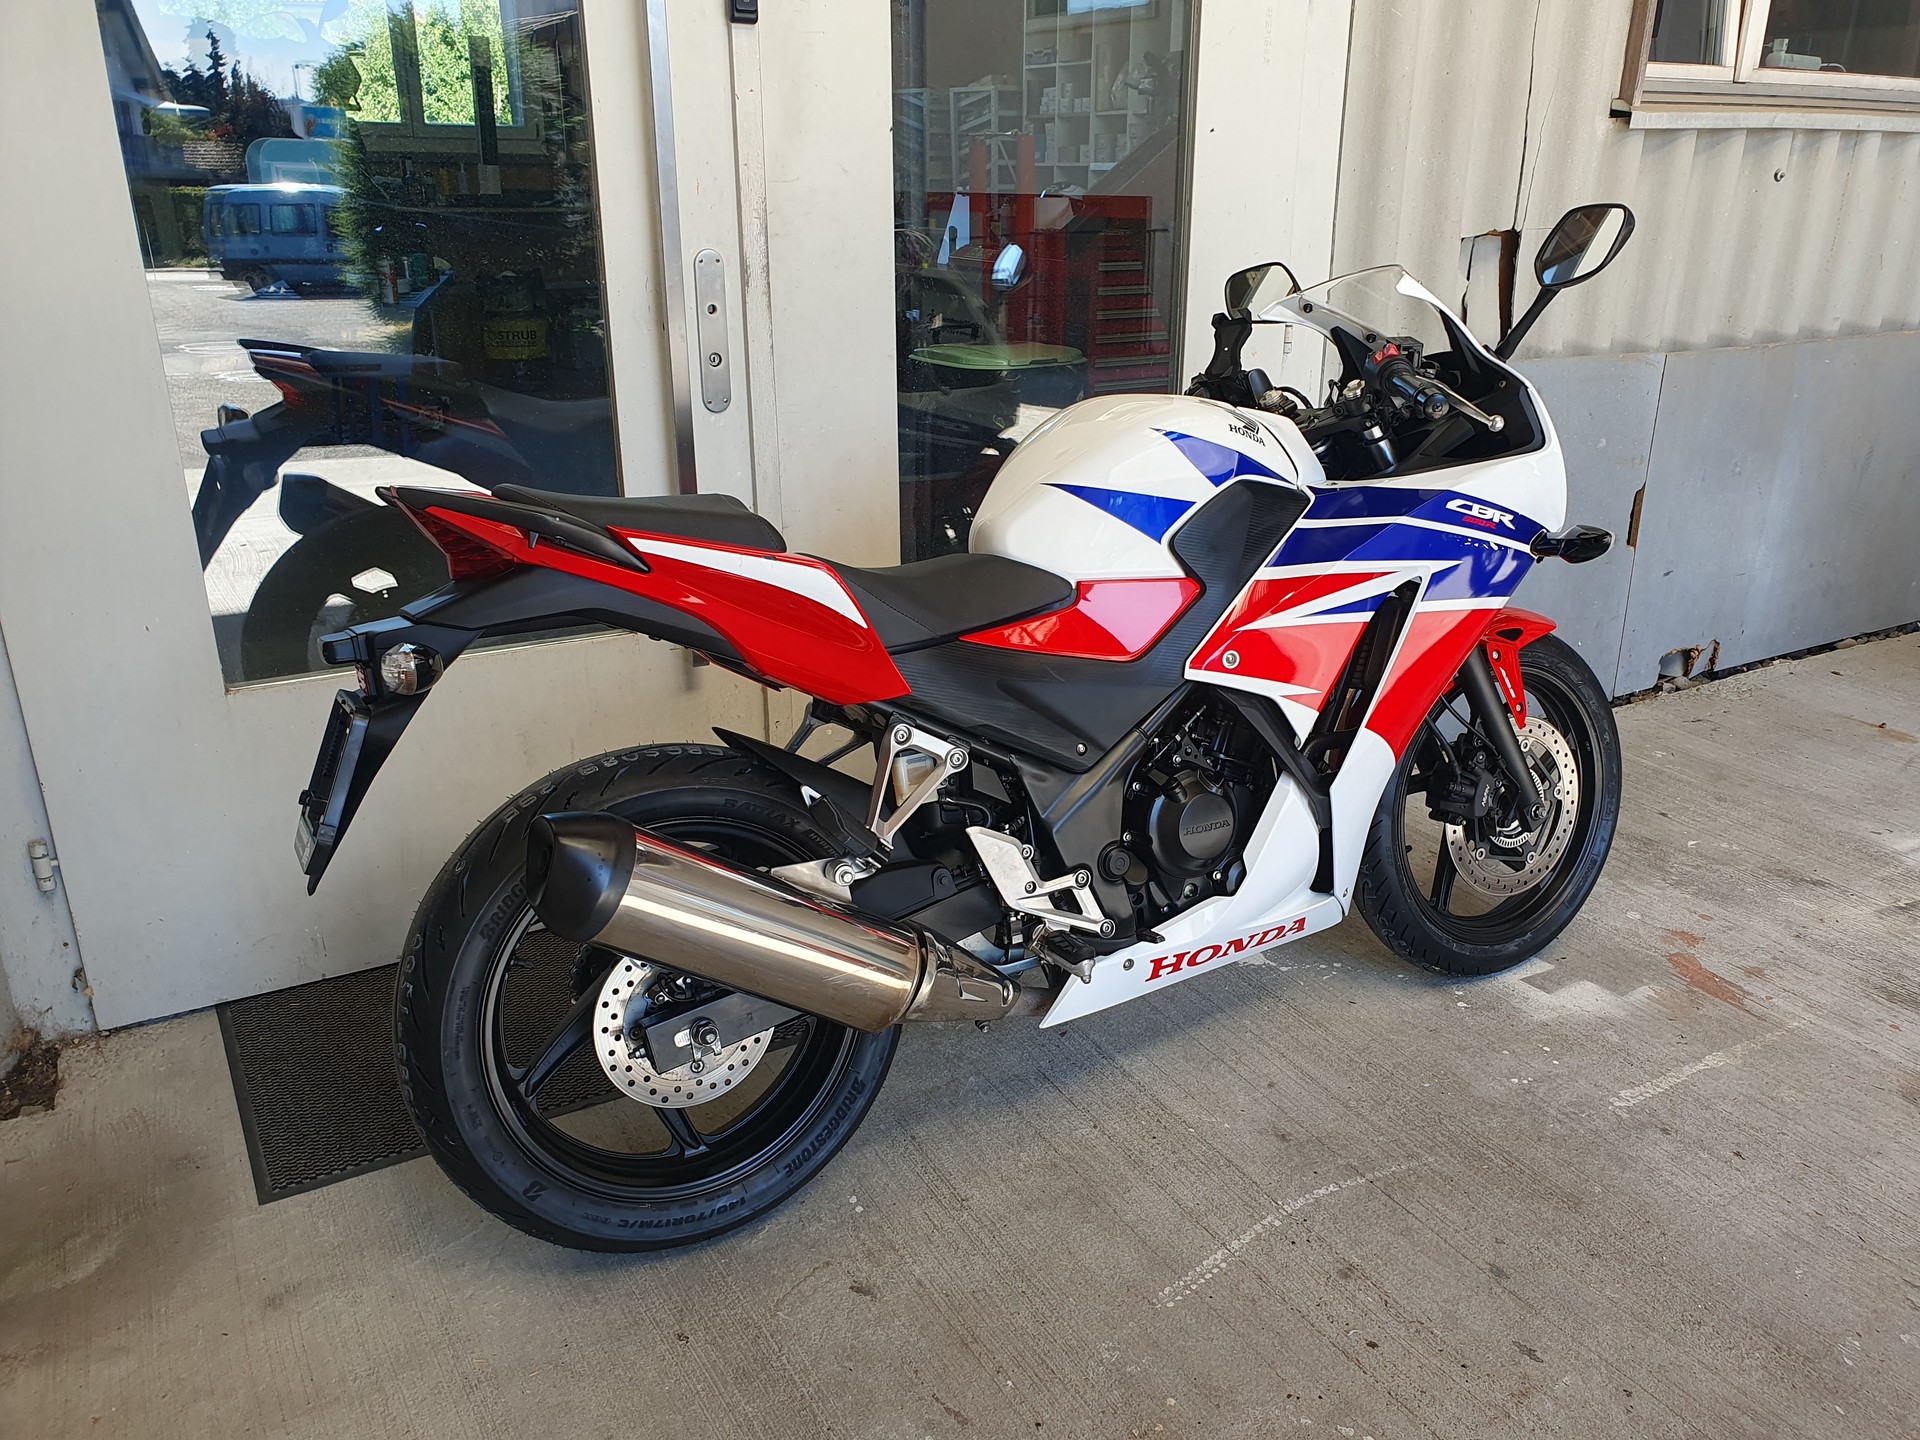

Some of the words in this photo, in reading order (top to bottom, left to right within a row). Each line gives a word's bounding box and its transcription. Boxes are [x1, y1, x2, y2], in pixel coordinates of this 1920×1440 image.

[497, 329, 538, 340] STRUB
[1228, 422, 1266, 448] HONDA
[1446, 498, 1516, 531] CBR
[1183, 818, 1231, 837] HONDA
[1145, 916, 1307, 982] HONDA
[783, 1077, 867, 1176] BRIDGESTONE
